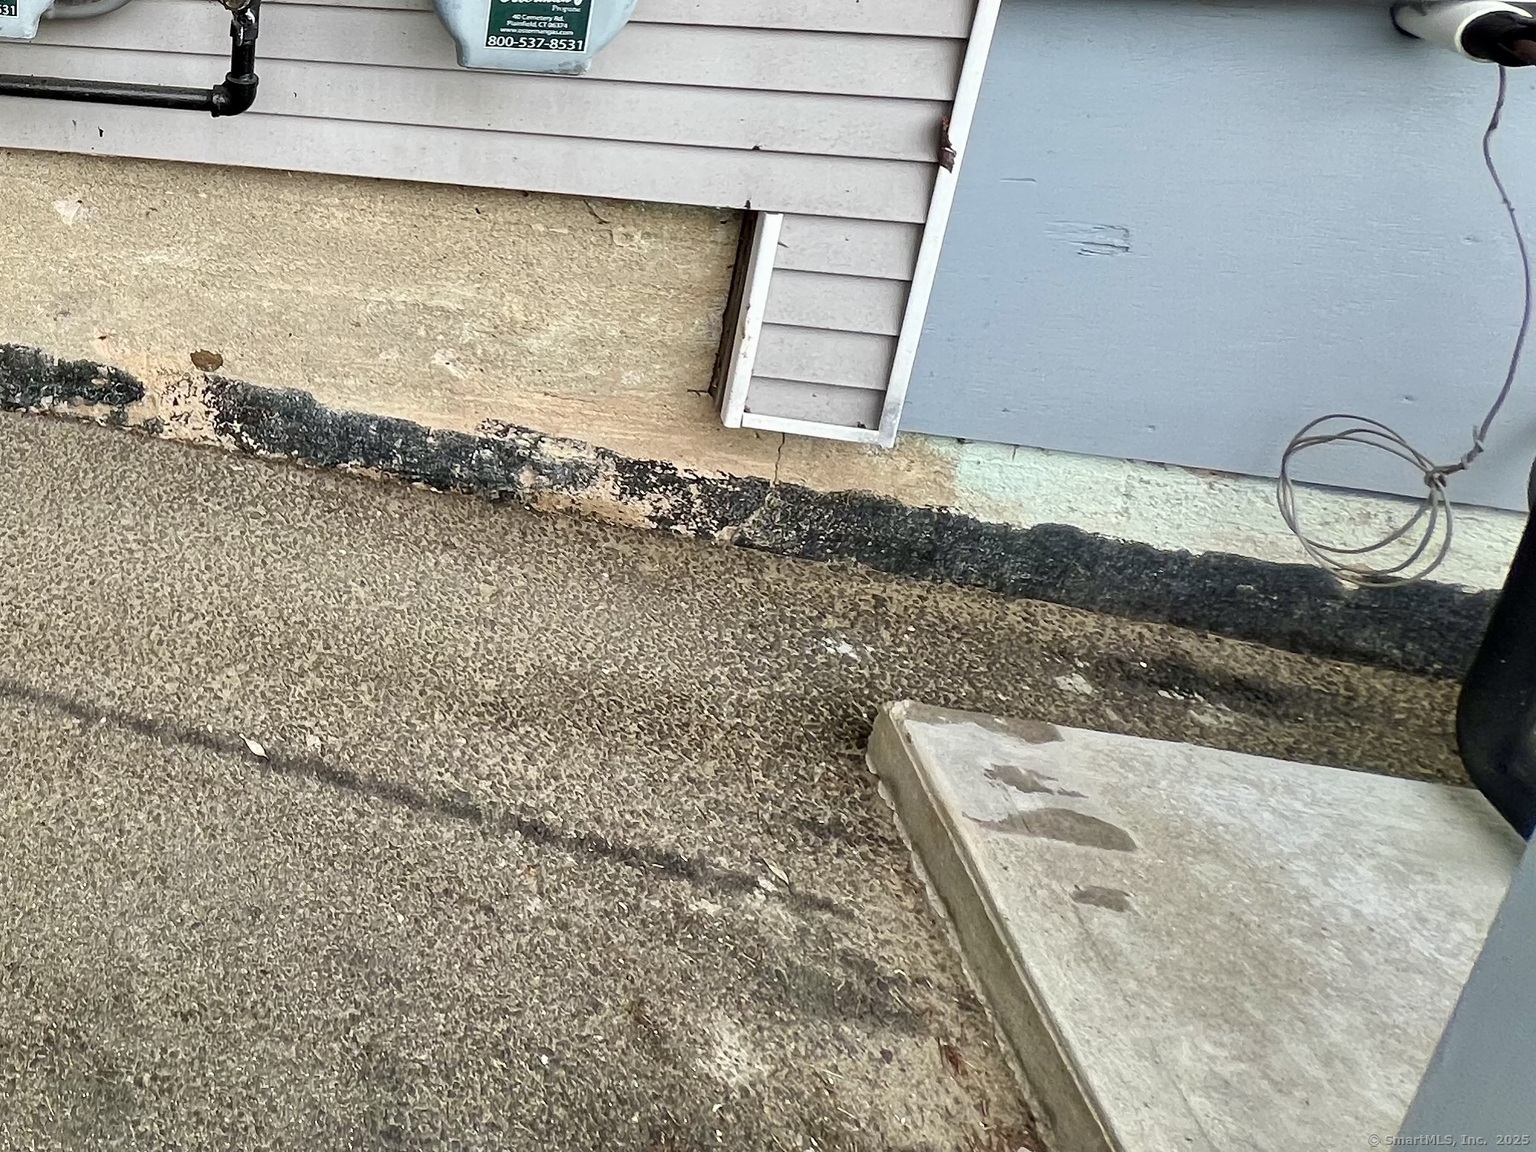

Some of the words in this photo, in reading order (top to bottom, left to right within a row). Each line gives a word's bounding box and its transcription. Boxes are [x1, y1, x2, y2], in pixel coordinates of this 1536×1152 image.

[552, 5, 581, 13] Propane
[521, 14, 552, 22] Cemetery
[488, 35, 583, 50] 800-537-8531
